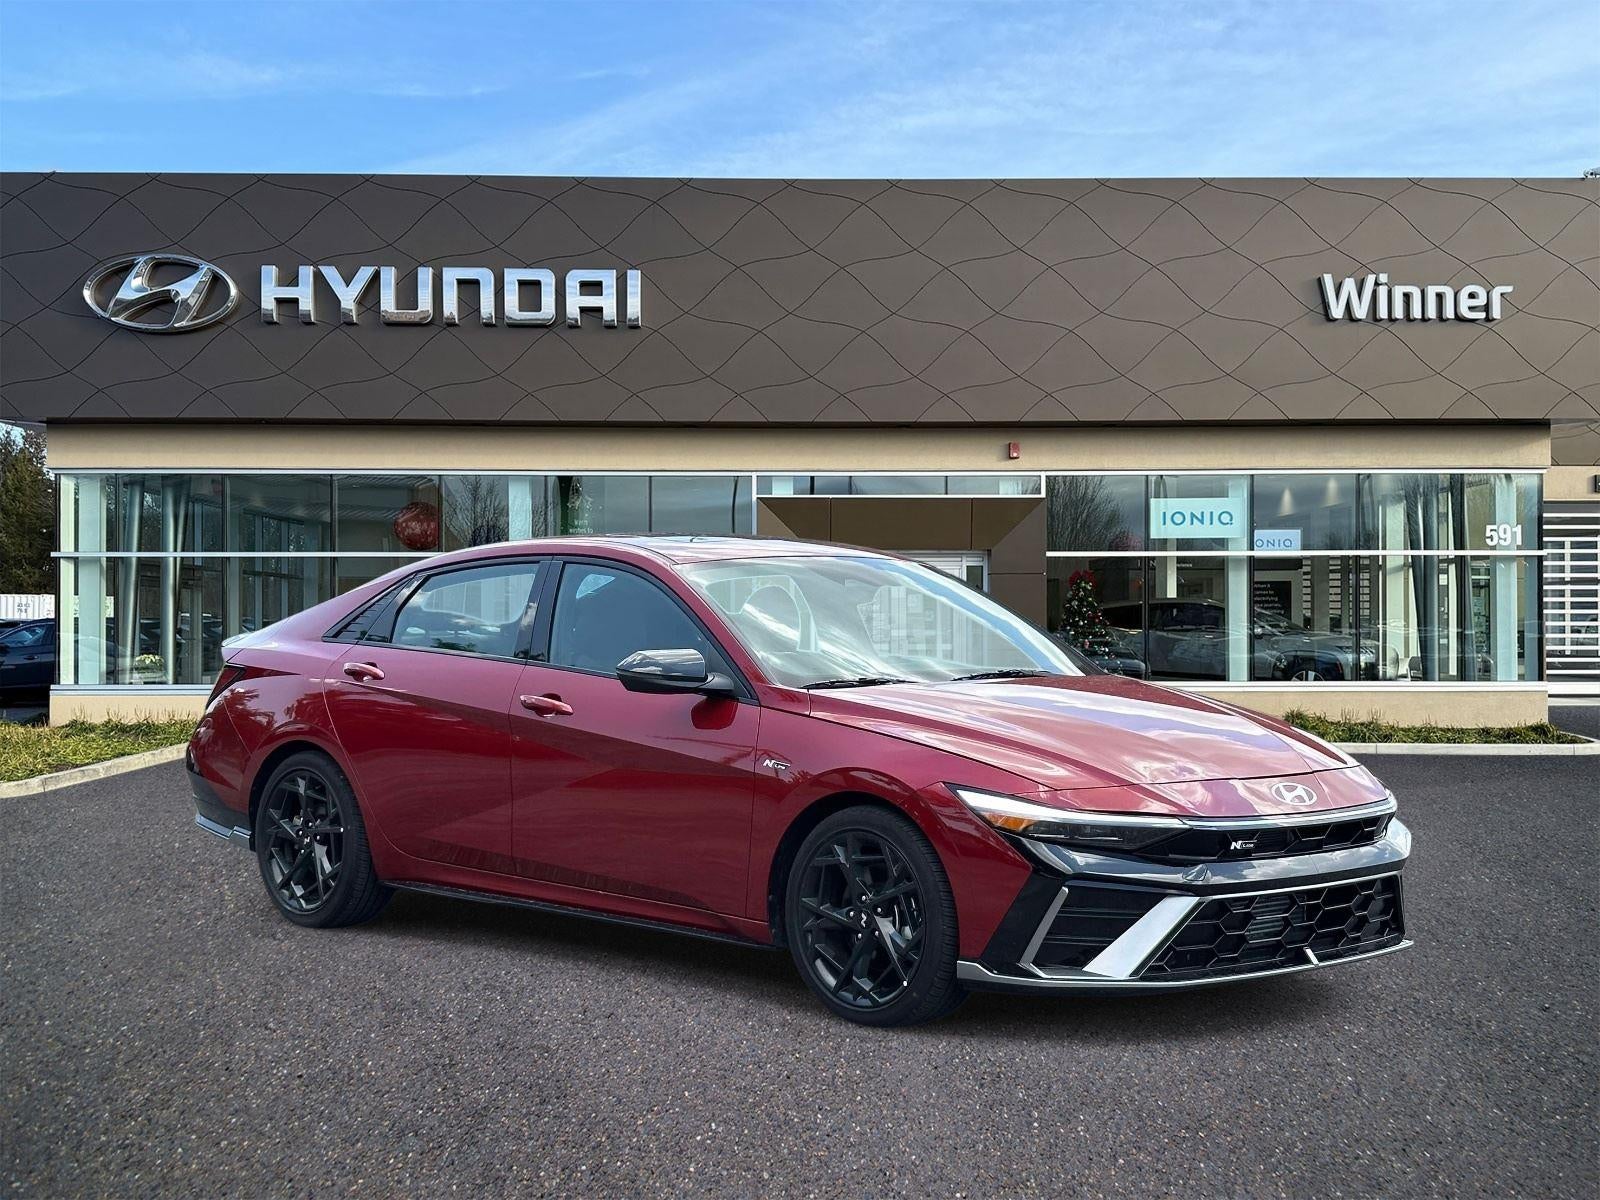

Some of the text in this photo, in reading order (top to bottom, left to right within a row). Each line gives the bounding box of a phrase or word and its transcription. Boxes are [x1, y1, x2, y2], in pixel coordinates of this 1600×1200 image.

[260, 265, 642, 328] HYUNDAI
[1319, 273, 1514, 321] Winner
[1161, 510, 1234, 526] IONIQ
[1255, 538, 1293, 548] ONIQ
[1485, 523, 1523, 546] 591
